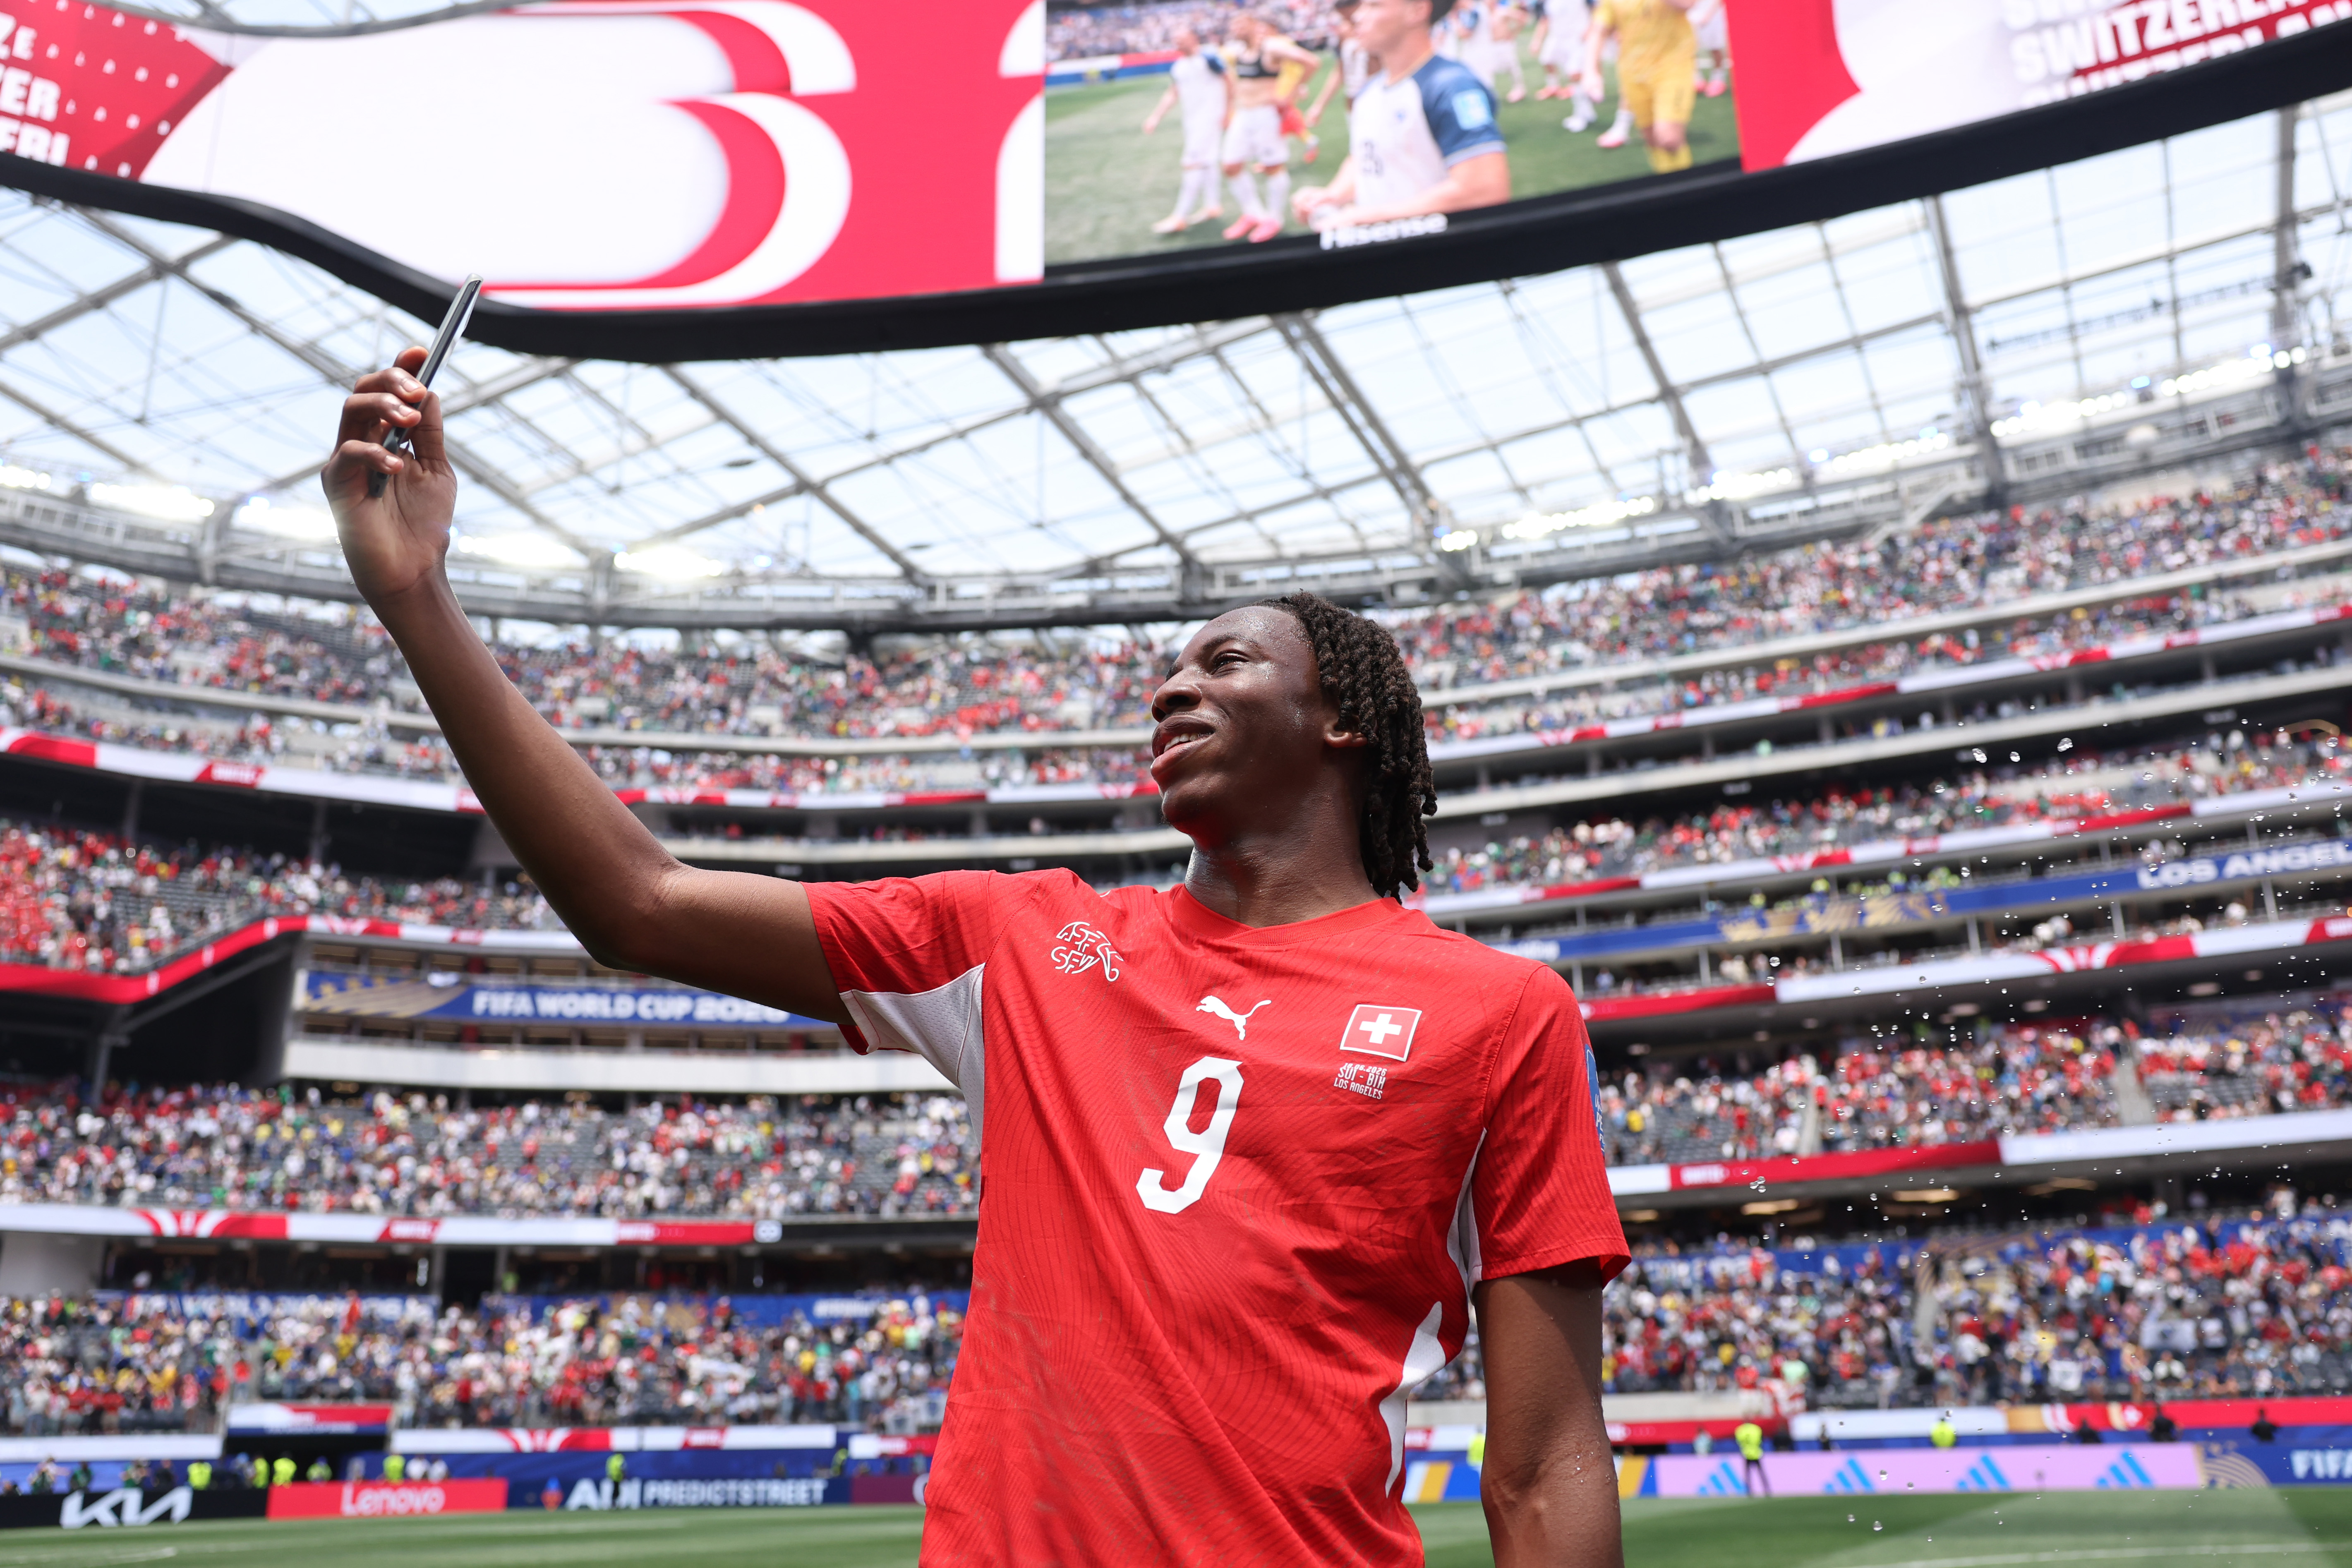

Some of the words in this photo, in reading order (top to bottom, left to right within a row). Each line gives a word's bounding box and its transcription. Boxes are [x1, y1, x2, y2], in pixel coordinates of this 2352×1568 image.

[2136, 858, 2218, 889] LOS
[472, 990, 535, 1017] FIFA
[535, 992, 636, 1019] WORLD
[636, 994, 694, 1021] CUP
[1338, 1067, 1357, 1081] SUI
[1366, 1072, 1386, 1090] BIH
[1342, 1062, 1388, 1077] 18.06.2026
[1333, 1077, 1349, 1089] LOS
[1349, 1081, 1383, 1100] ANGELES
[1136, 1056, 1244, 1214] 9
[340, 1482, 446, 1516] Lenovo
[643, 1478, 828, 1506] PREDICTSTREET
